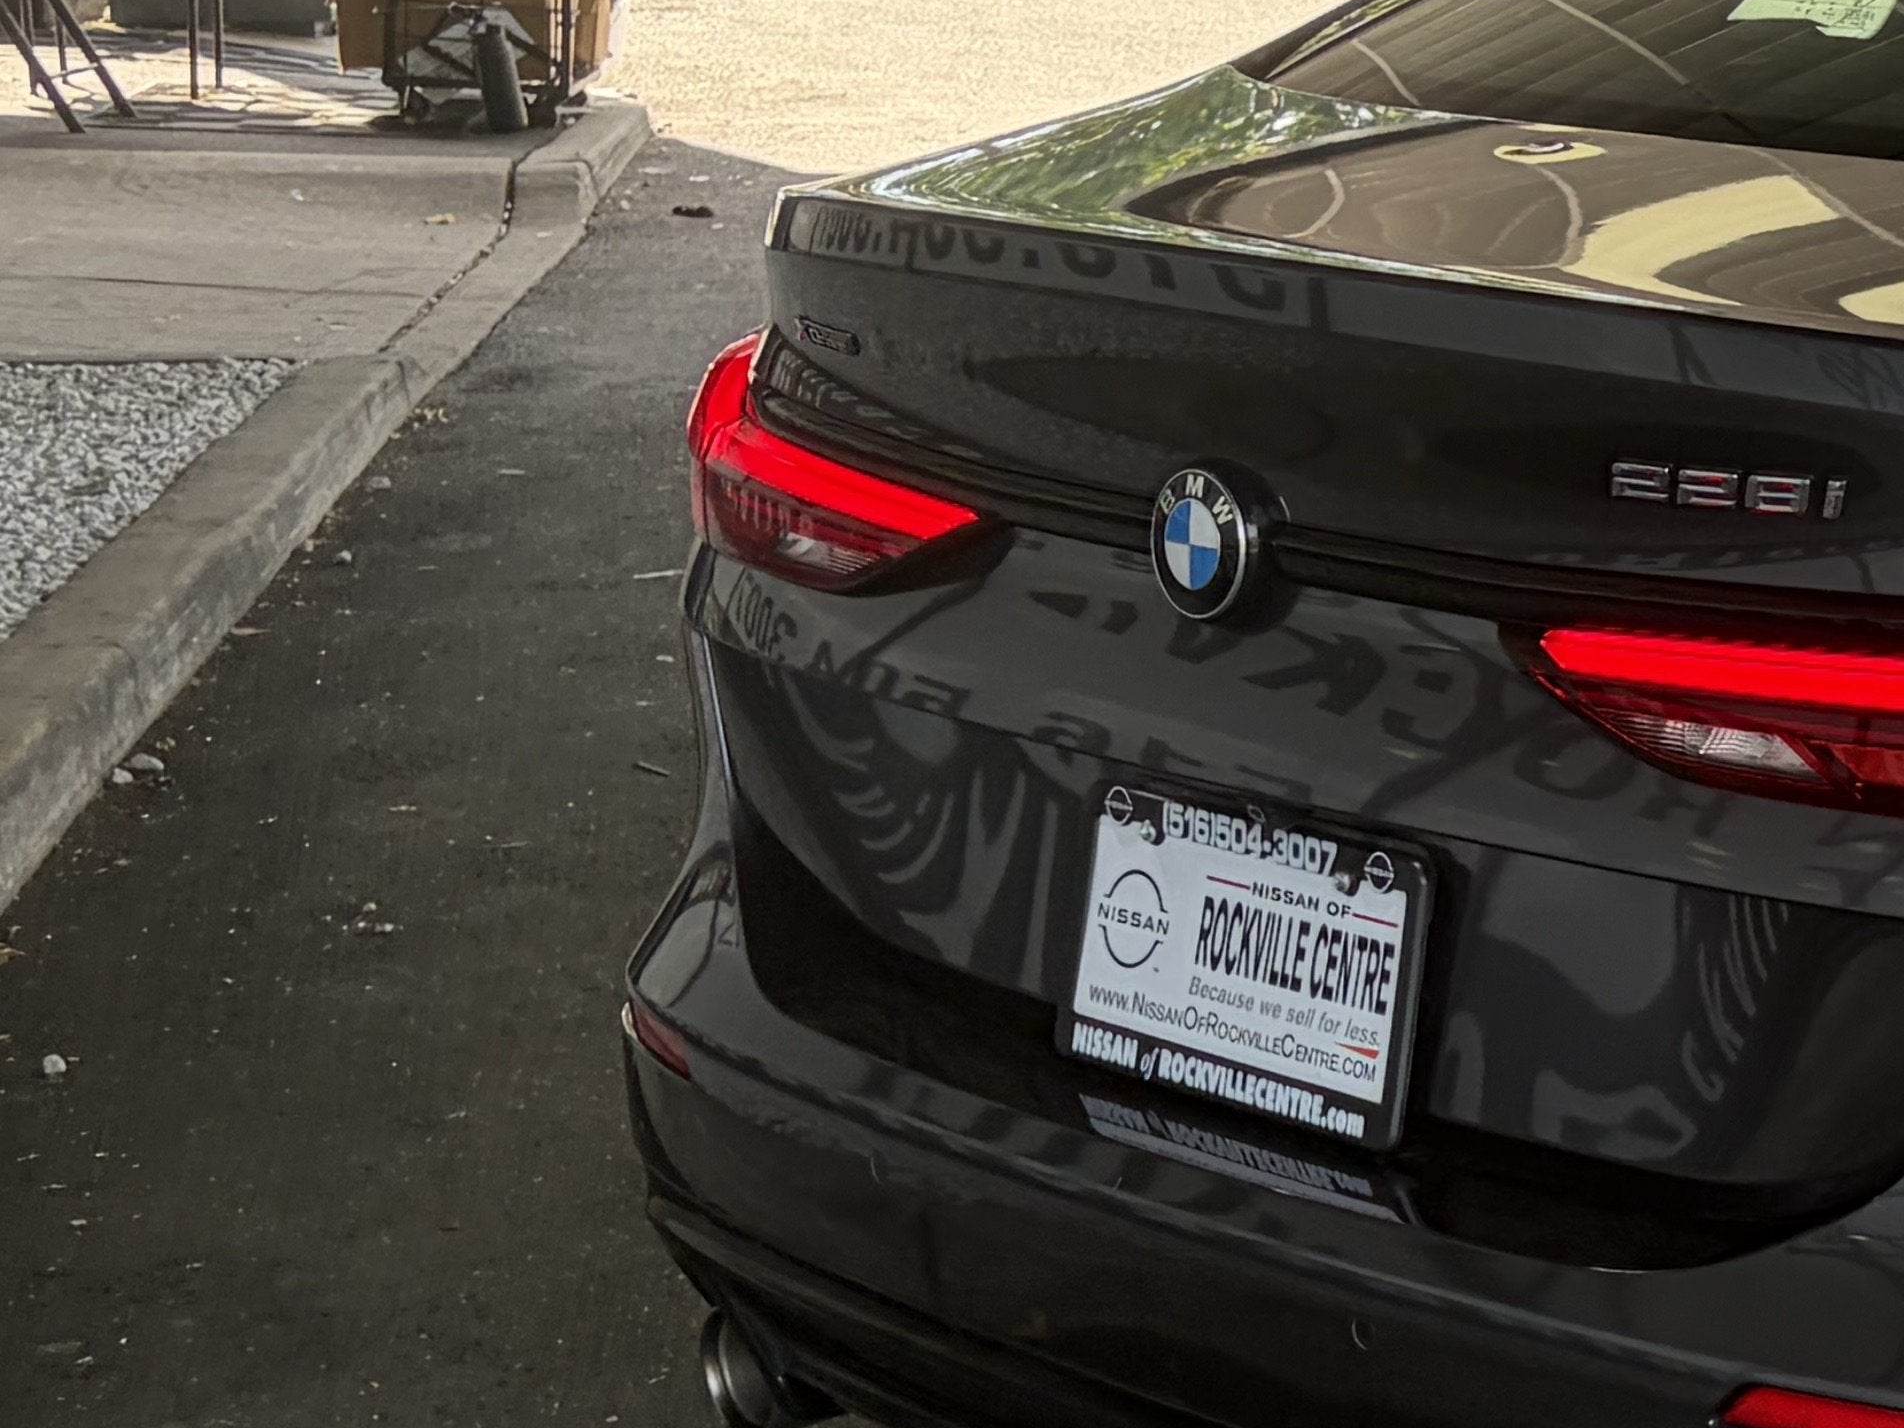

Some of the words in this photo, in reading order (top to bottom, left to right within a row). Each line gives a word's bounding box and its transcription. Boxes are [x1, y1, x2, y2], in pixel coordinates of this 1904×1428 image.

[1159, 473, 1234, 525] BMW
[1611, 460, 1847, 520] 228i
[1097, 901, 1170, 936] NISSAN
[1252, 881, 1320, 913] NISSAN
[1326, 901, 1353, 920] OF
[1194, 894, 1311, 993] ROCKVILLE
[1309, 923, 1395, 1016] CENTRE
[1188, 975, 1254, 1012] Because
[1259, 1000, 1282, 1020] we
[1285, 1005, 1316, 1029] sell
[1318, 1011, 1342, 1038] for
[1071, 1021, 1139, 1070] NISSAN
[1140, 1047, 1160, 1081] of
